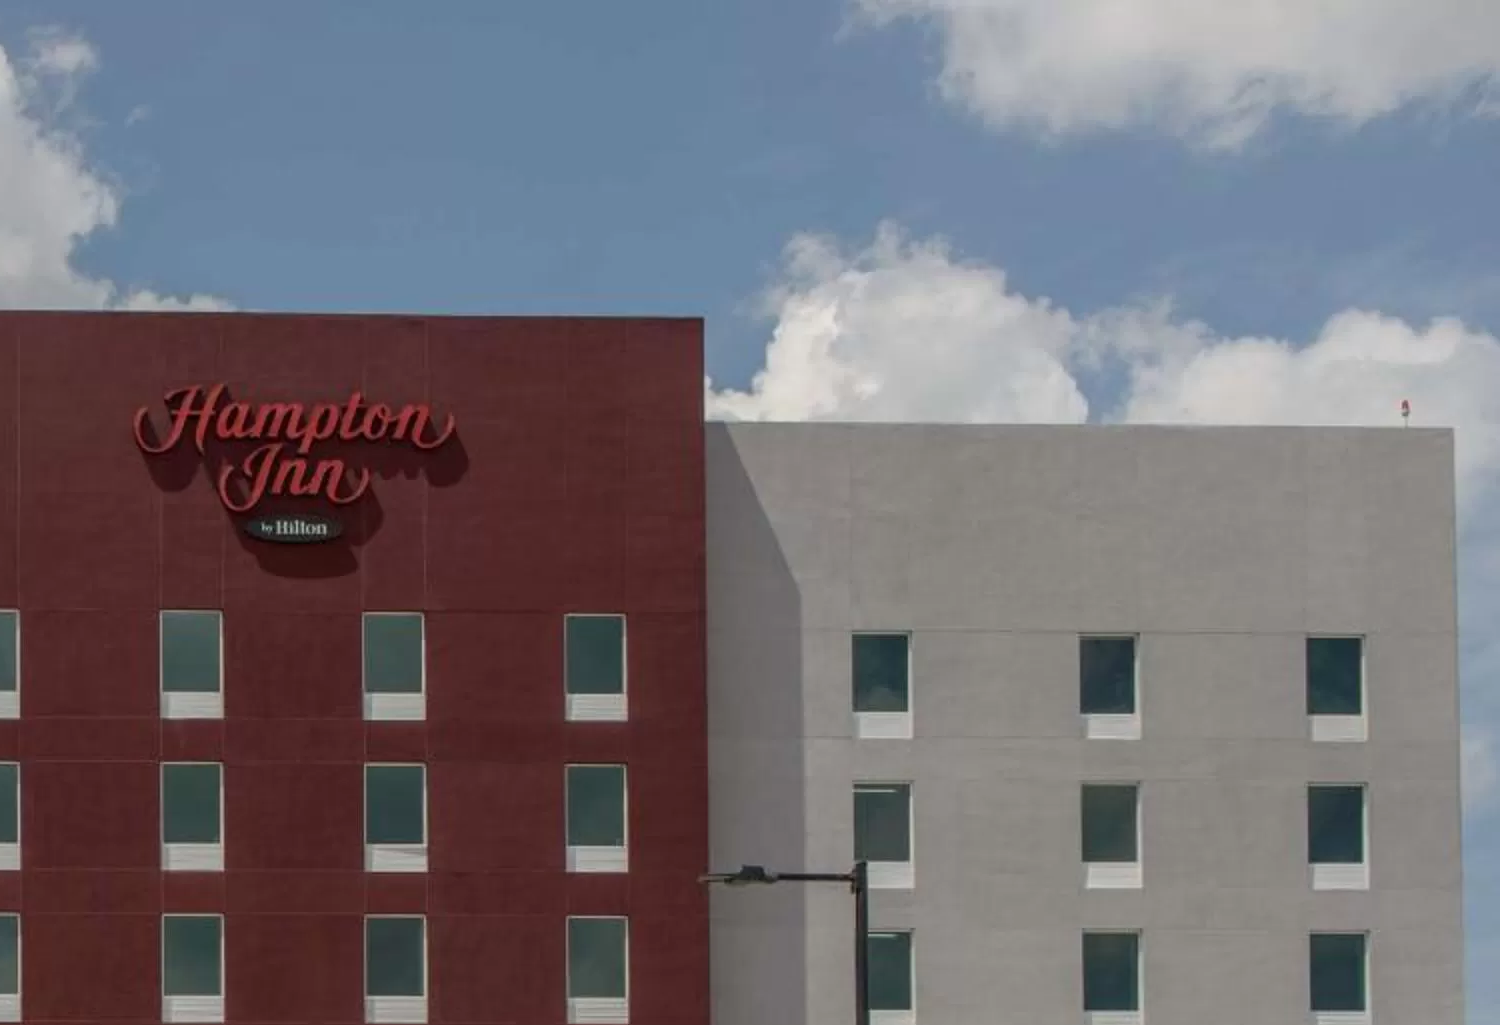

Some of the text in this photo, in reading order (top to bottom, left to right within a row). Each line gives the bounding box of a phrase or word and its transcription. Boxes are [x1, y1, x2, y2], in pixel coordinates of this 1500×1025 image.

[133, 383, 455, 453] Hampton
[219, 443, 369, 512] Inn
[261, 520, 327, 536] by Hilton
